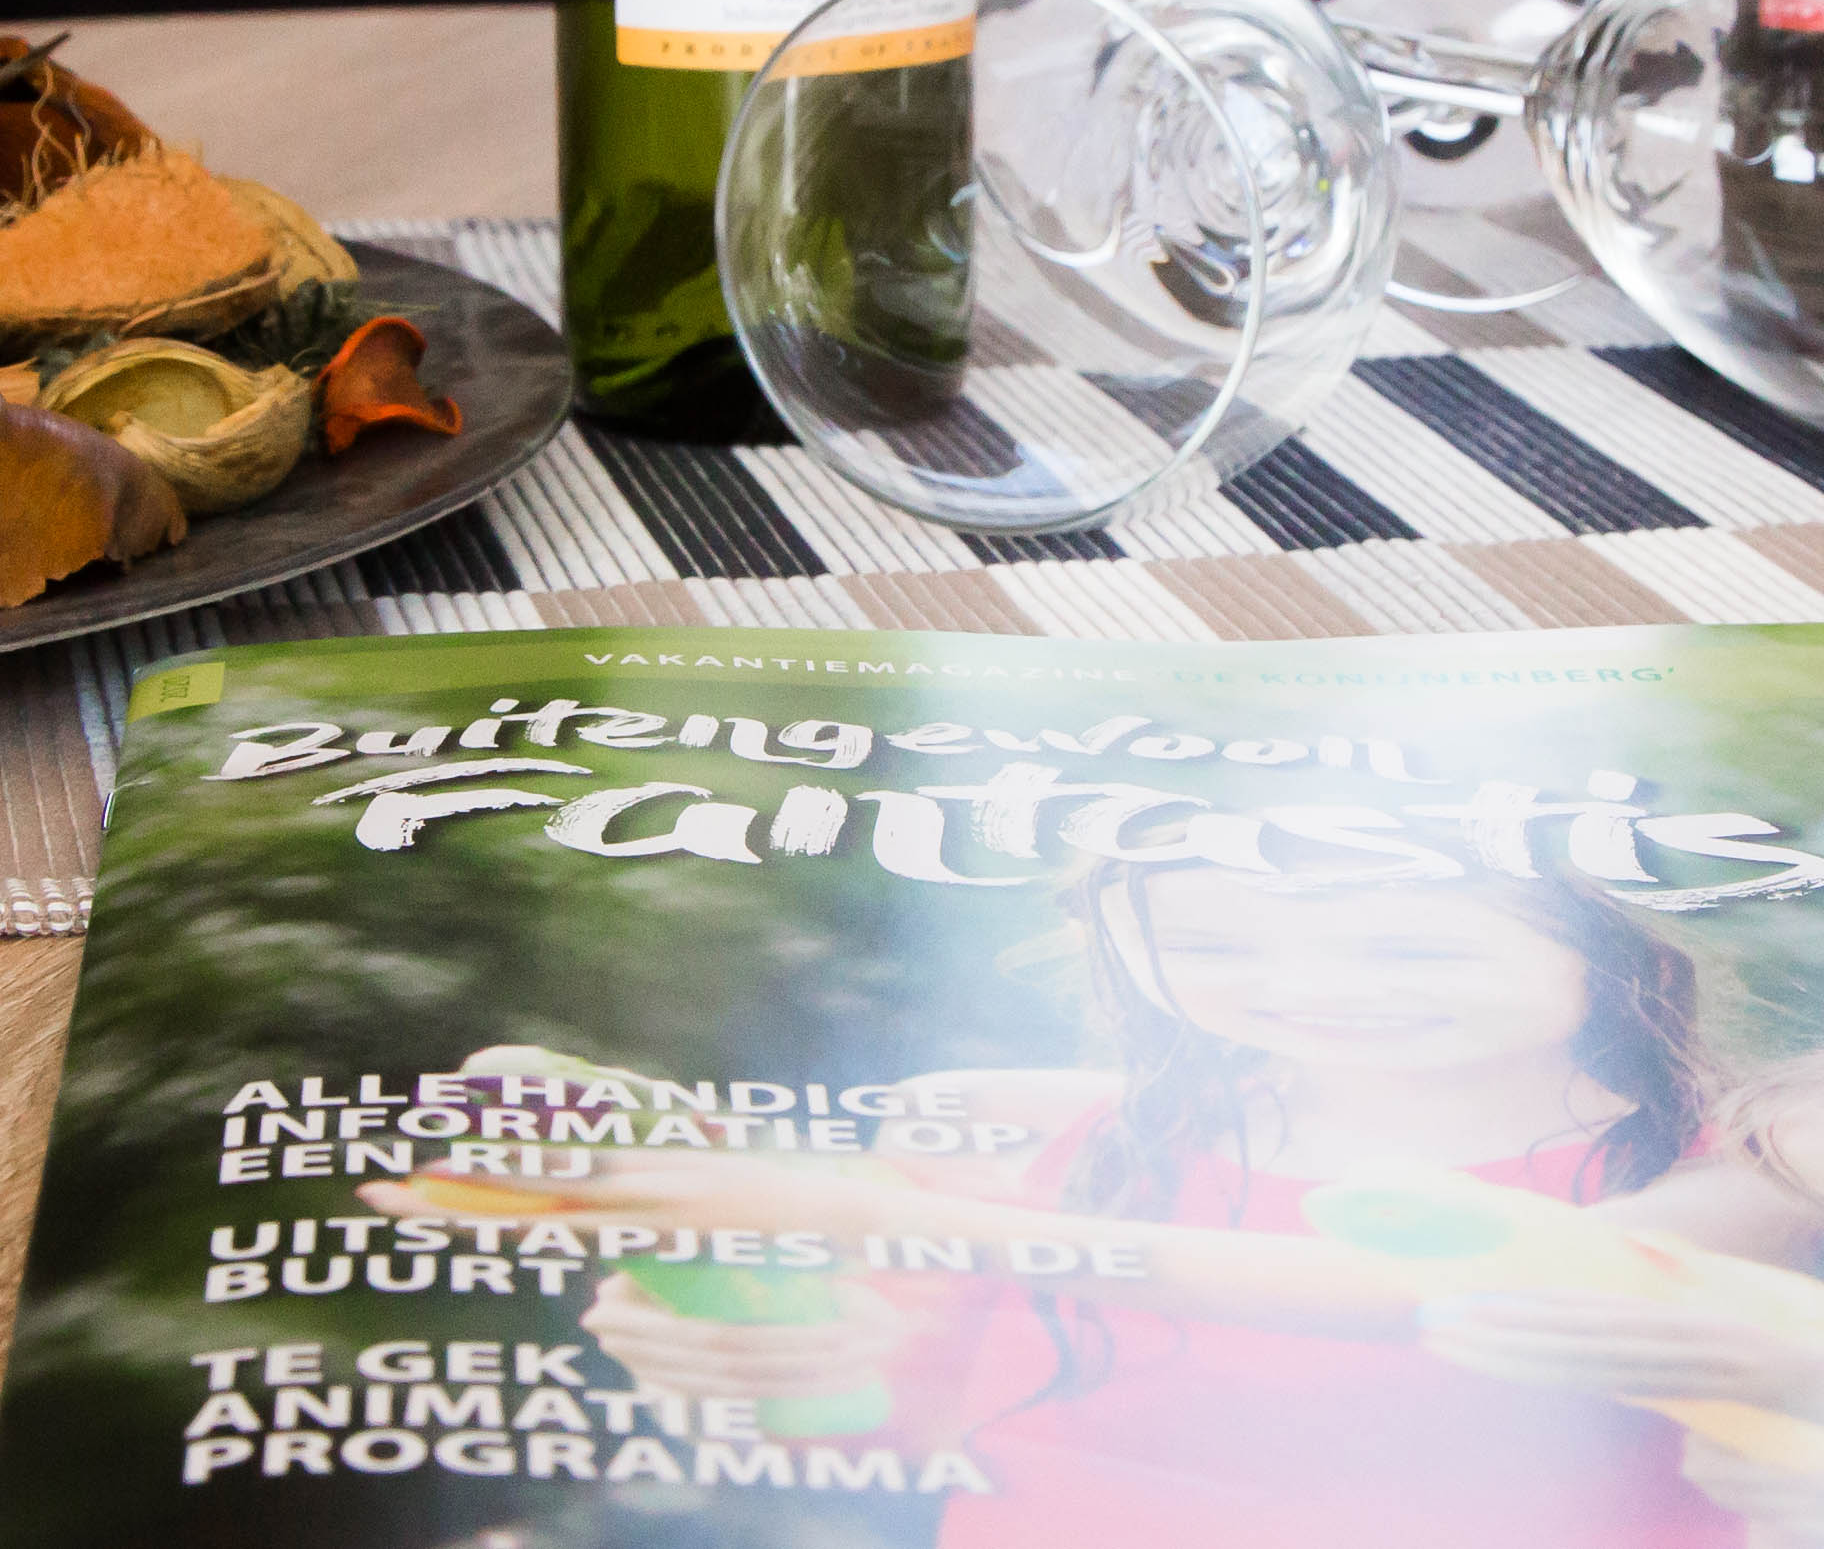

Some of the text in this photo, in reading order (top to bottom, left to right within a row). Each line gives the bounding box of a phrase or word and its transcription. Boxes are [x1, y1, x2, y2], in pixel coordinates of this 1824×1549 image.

[584, 653, 1138, 682] VAKANTIEMAGAZINE
[202, 698, 1449, 783] Buitengewoon
[220, 1072, 969, 1119] ALLE HANDIGE
[222, 1106, 1031, 1154] INFORMATIE OP
[217, 1142, 593, 1184] EEN RIJ
[209, 1216, 1148, 1279] UITSTAPJES IN DE
[203, 1254, 584, 1304] BUURT
[190, 1340, 587, 1391] TE GEK
[184, 1384, 764, 1442] ANIMATIE
[182, 1428, 995, 1496] PROGRAMMA
